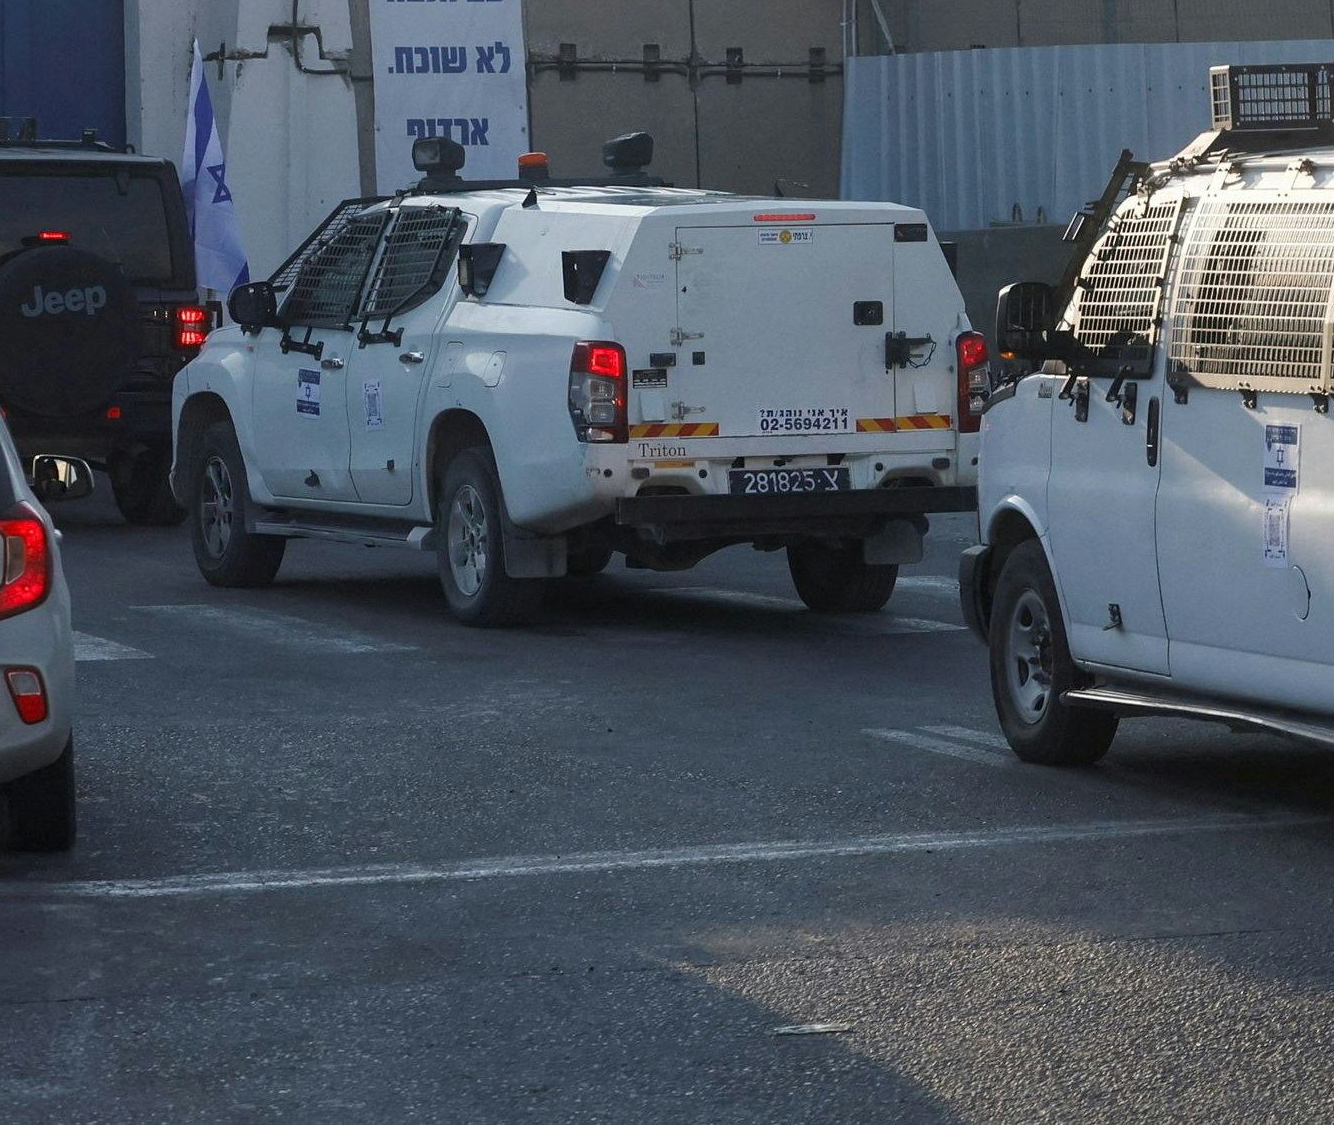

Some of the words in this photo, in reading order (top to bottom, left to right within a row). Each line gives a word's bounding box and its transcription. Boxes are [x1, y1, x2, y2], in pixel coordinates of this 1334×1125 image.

[388, 46, 466, 74] שוכח.
[475, 41, 511, 74] לא
[21, 285, 107, 317] Jeep
[807, 409, 825, 417] אני
[829, 409, 848, 418] איך
[760, 417, 848, 431] 02-5694211
[638, 443, 687, 457] Triton
